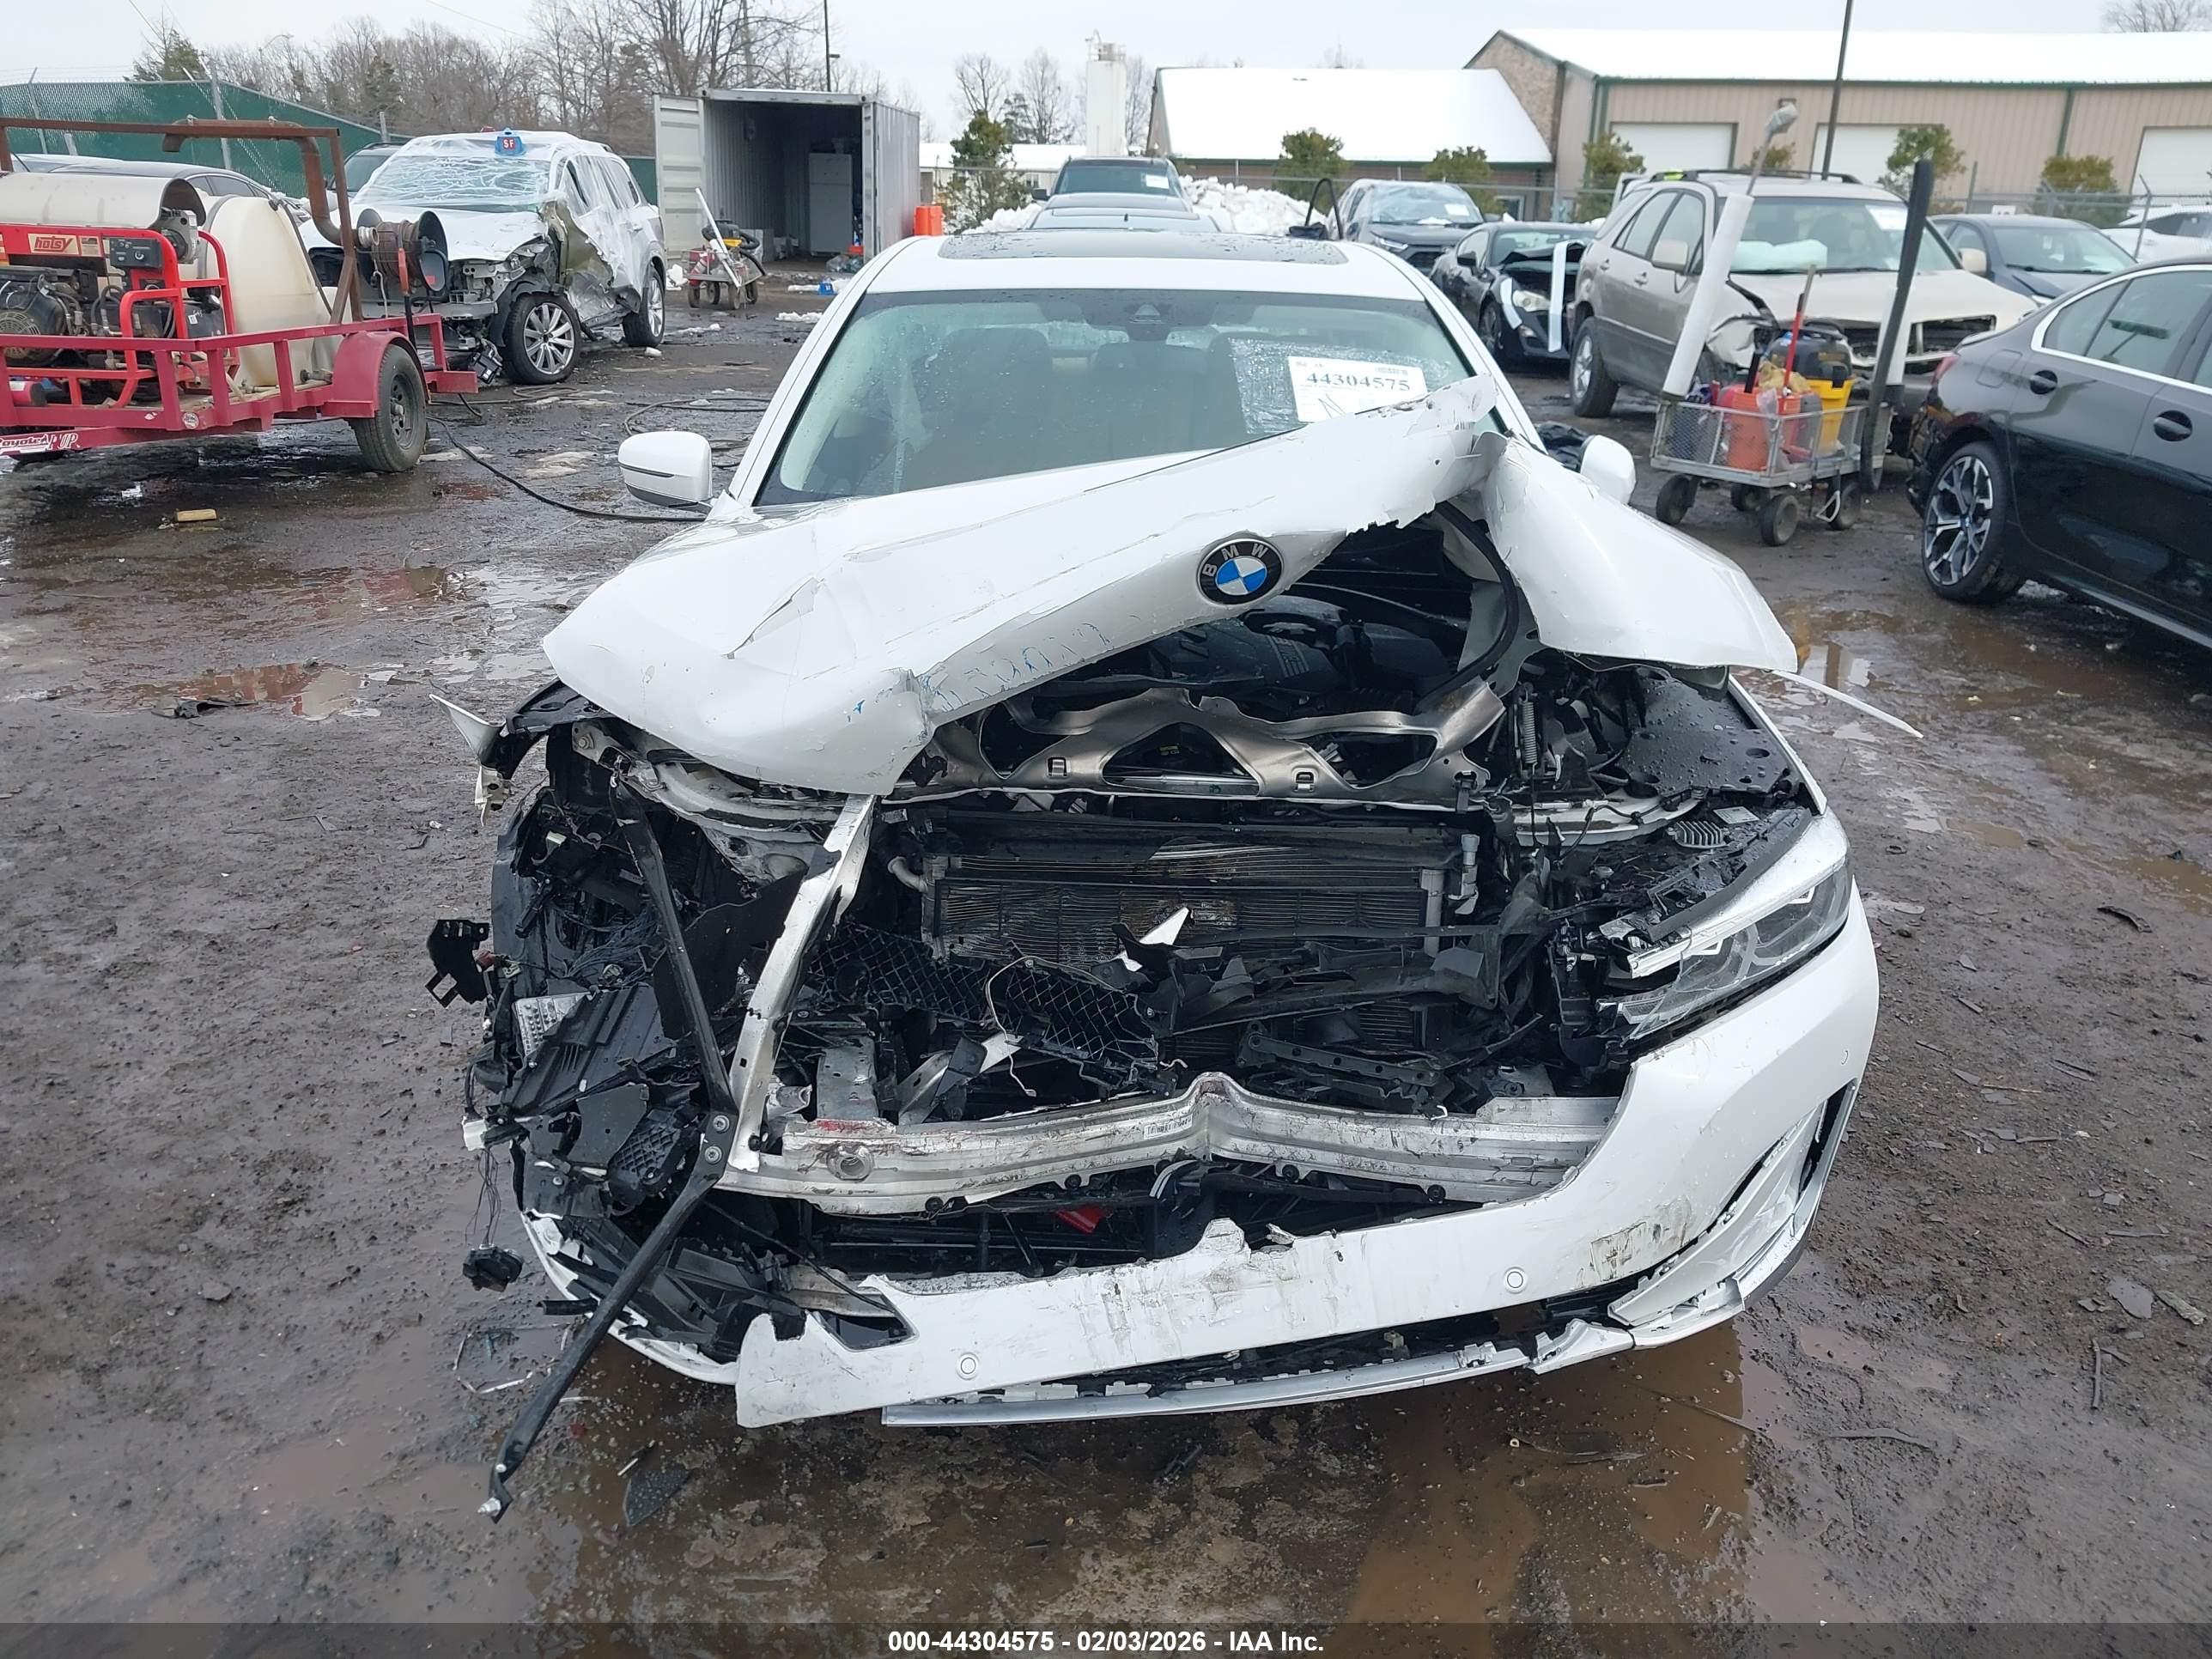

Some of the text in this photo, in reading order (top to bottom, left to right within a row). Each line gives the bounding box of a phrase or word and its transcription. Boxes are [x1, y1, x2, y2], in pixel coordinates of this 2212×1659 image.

[34, 236, 74, 252] hotsy
[1306, 372, 1411, 392] 44304575
[1202, 543, 1268, 577] BMW
